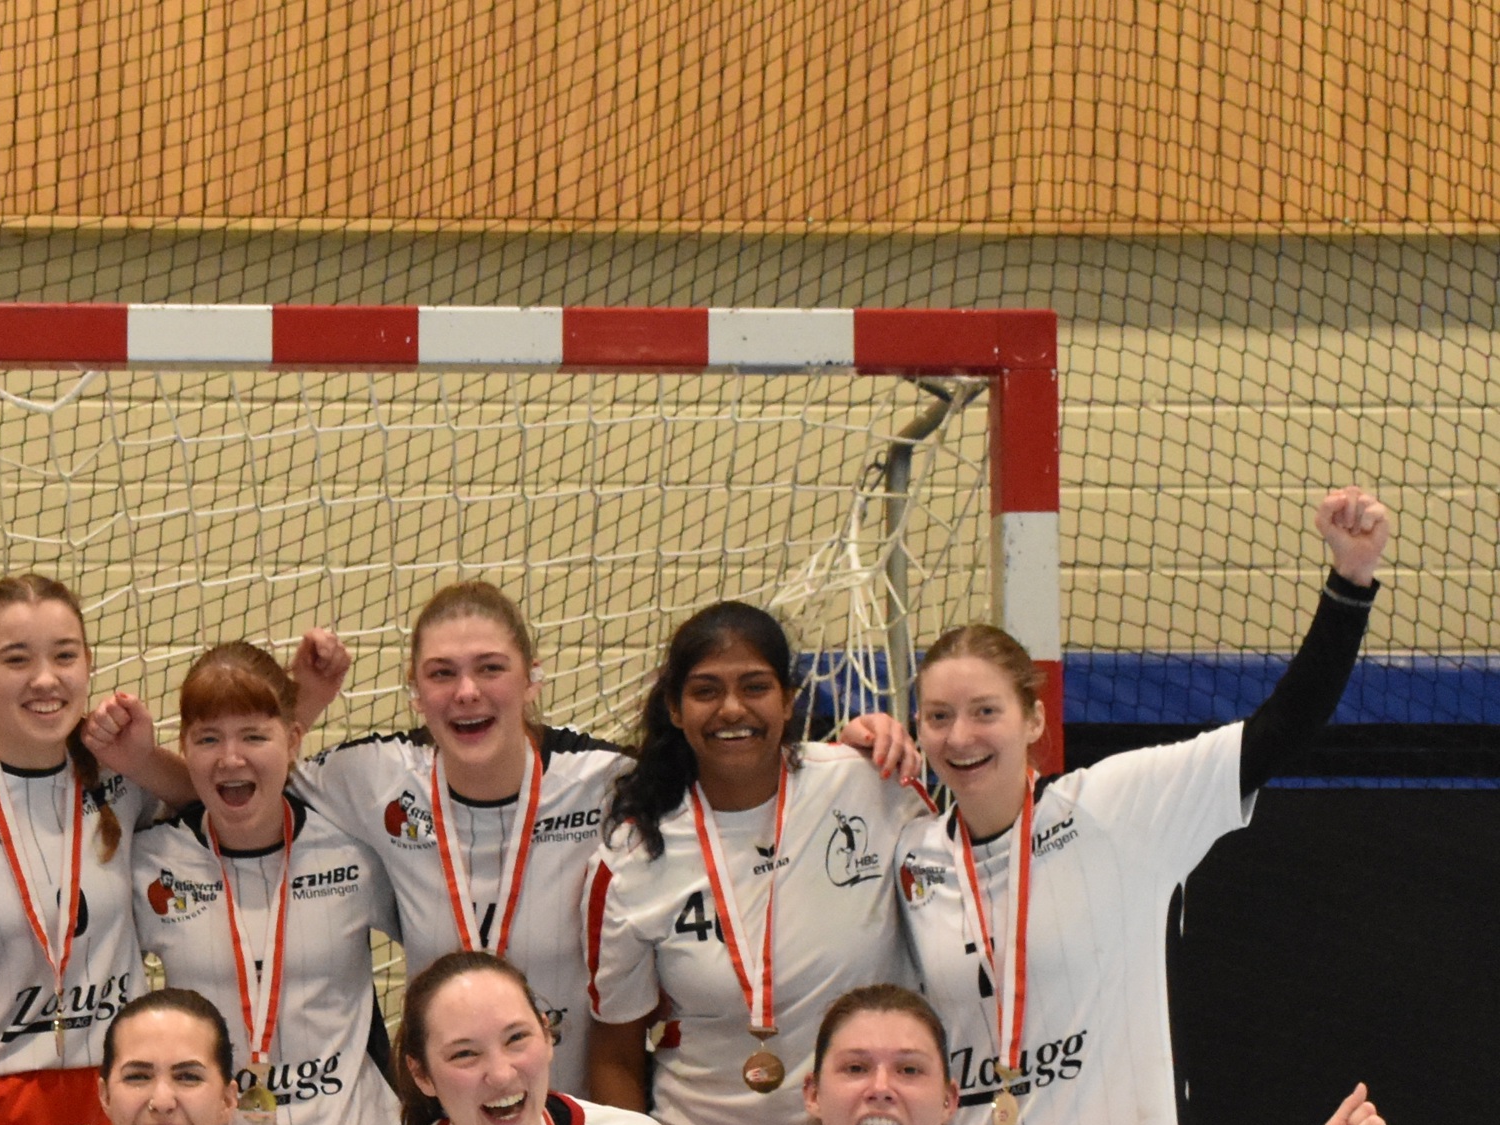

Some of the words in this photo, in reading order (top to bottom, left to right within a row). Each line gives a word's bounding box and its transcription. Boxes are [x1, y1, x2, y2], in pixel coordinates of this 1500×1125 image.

[555, 809, 601, 830] HBC
[855, 854, 879, 869] HBC
[318, 865, 359, 886] HBC
[292, 884, 359, 900] Münsingen
